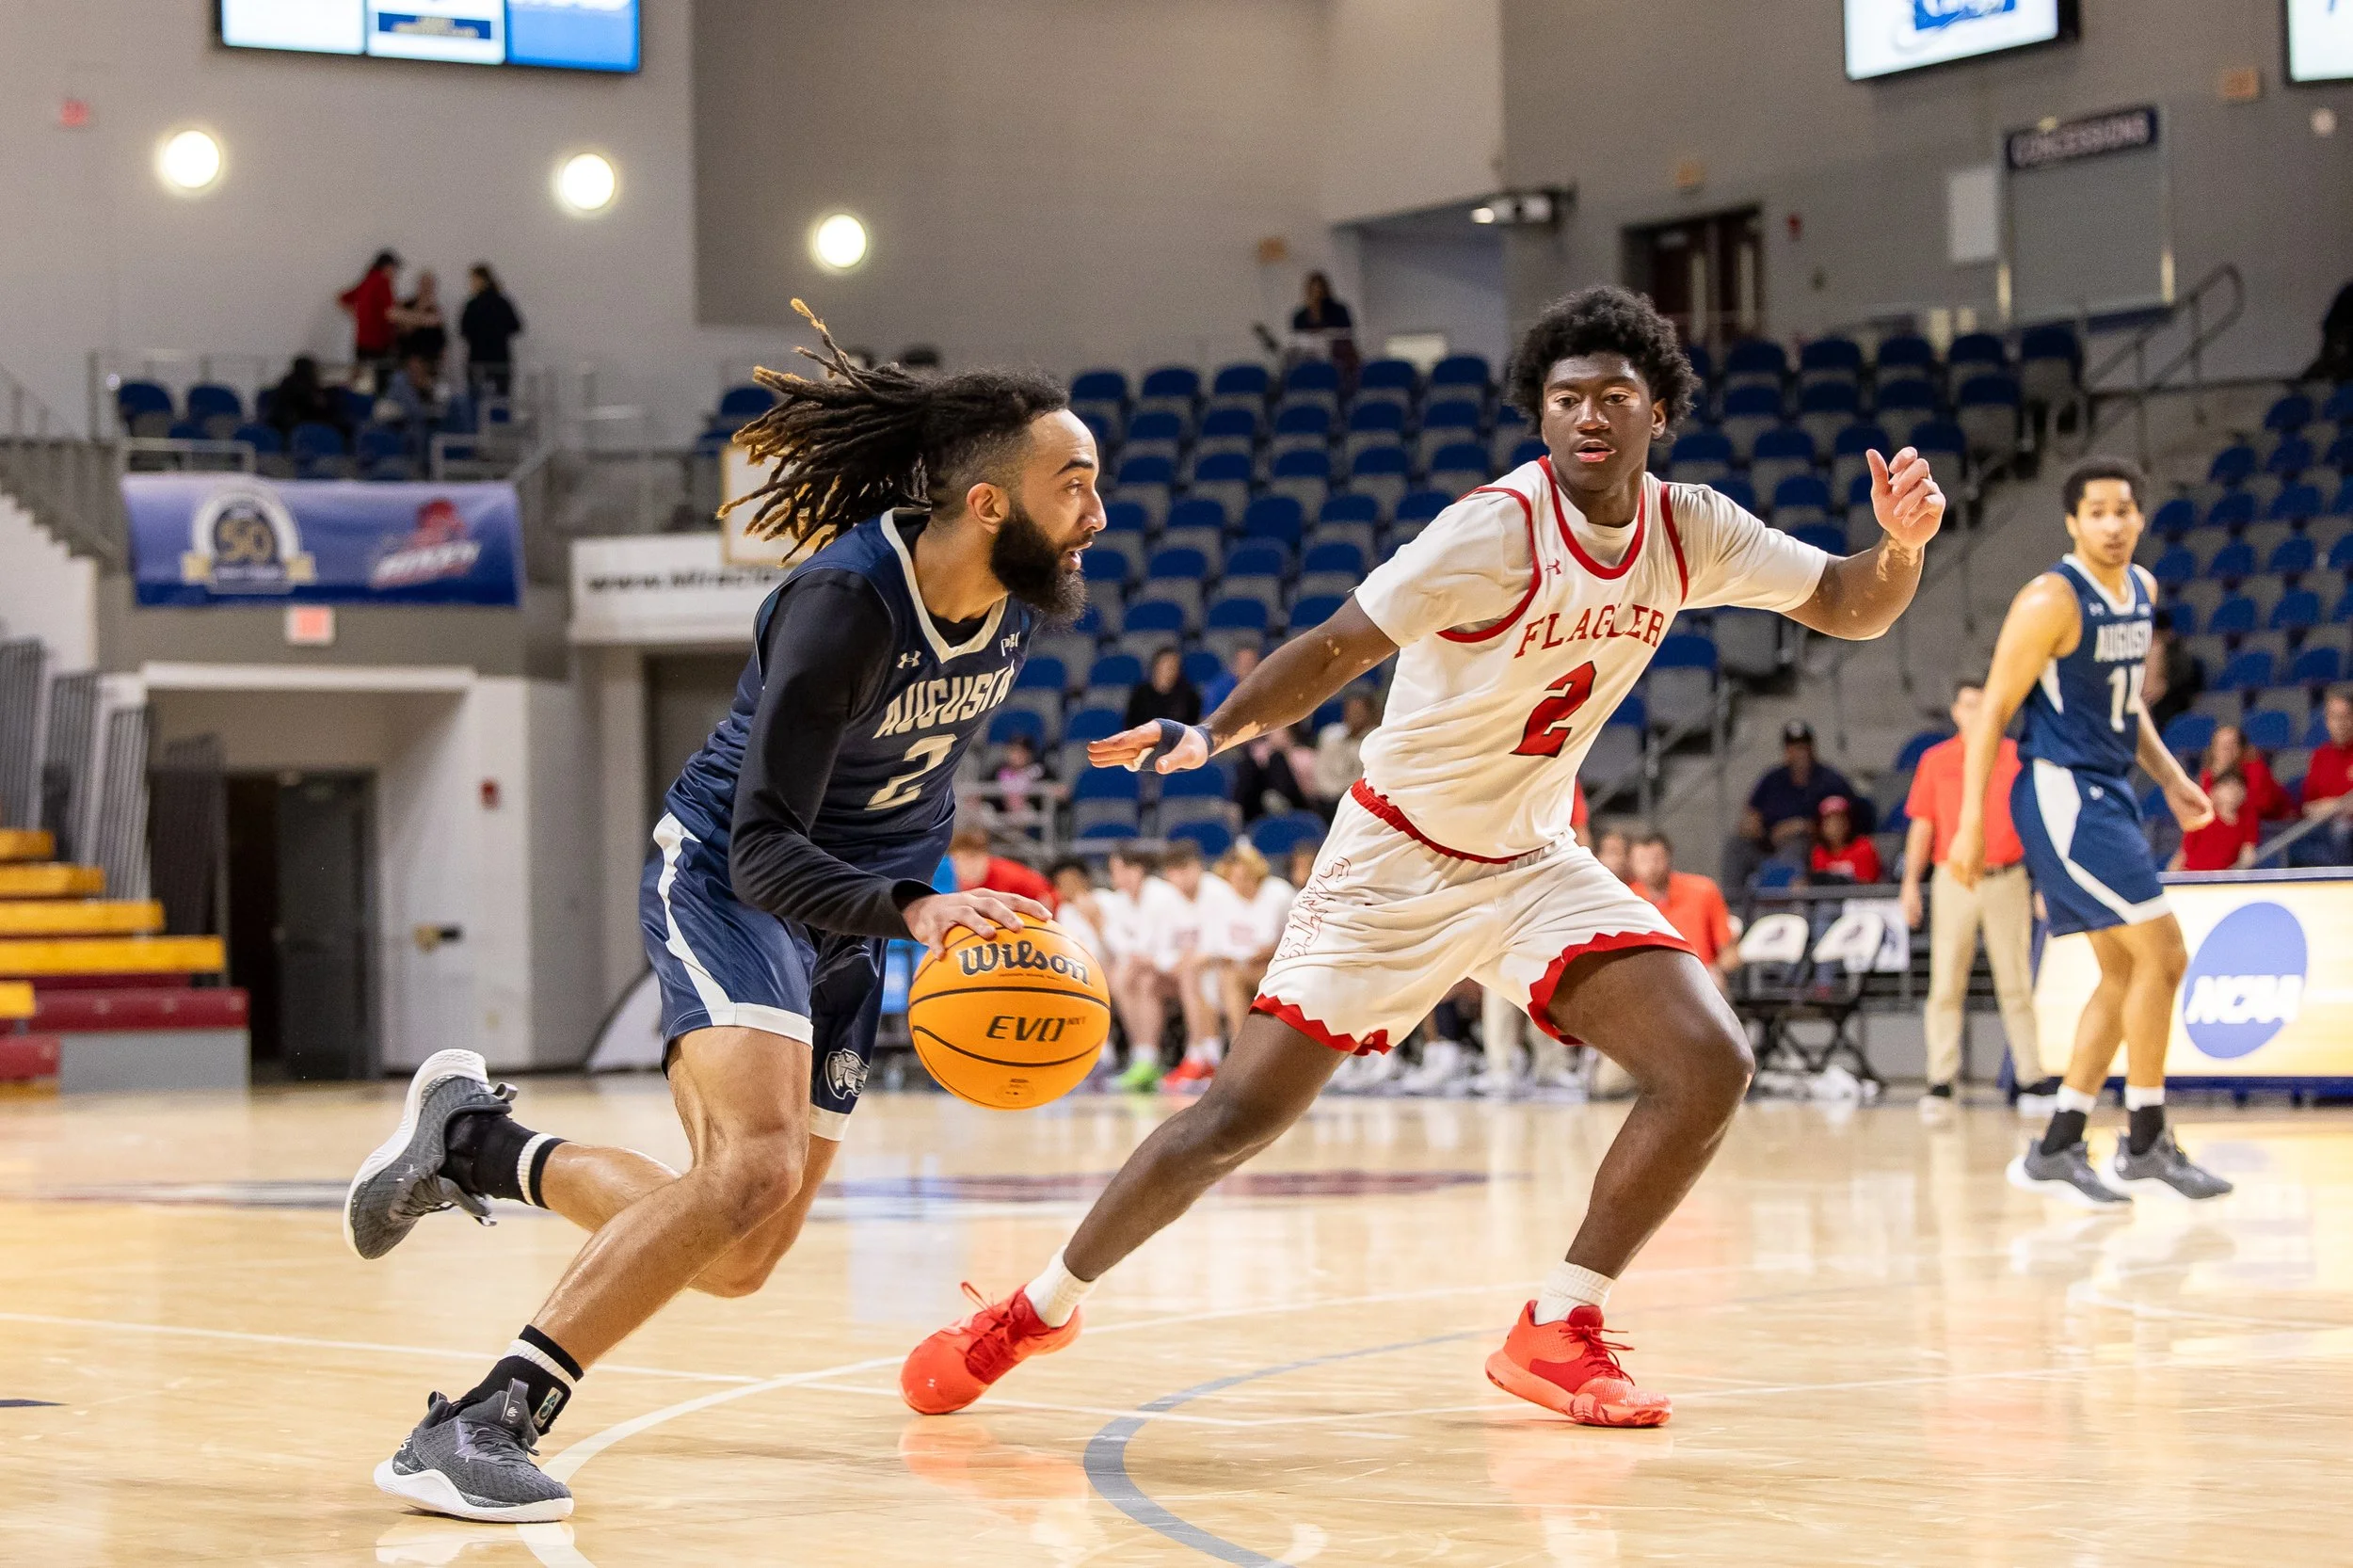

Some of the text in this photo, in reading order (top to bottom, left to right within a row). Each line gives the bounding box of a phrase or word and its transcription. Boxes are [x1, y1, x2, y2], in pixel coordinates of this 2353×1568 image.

[872, 660, 1015, 739] AUGUSTA
[1508, 660, 1597, 759] 2
[2106, 664, 2146, 733] 14
[864, 733, 958, 810] 2
[957, 940, 1092, 986] Wilson
[986, 1015, 1065, 1043] EVO
[2184, 974, 2304, 1025] NCAA
